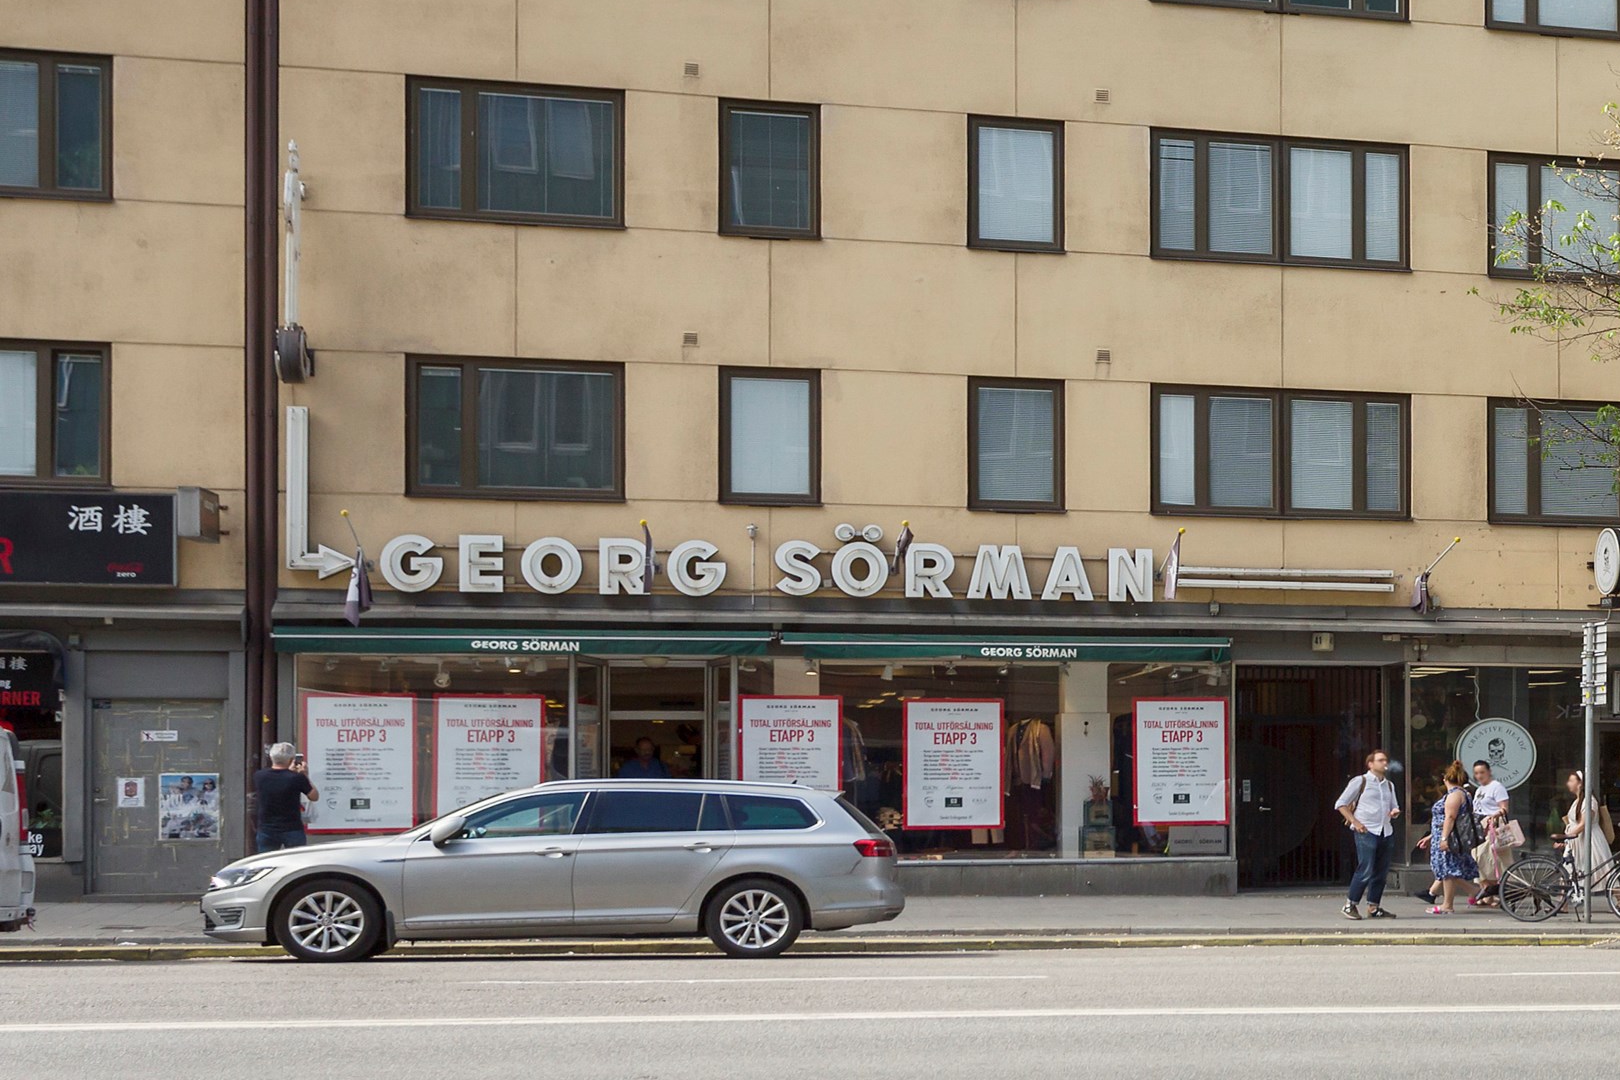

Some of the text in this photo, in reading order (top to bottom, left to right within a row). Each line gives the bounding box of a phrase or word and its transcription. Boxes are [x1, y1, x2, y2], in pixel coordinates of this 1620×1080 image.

[67, 504, 152, 535] 酒樓
[380, 523, 1154, 602] GEORG SÖRMAN
[471, 638, 580, 652] GEORG SÖRMAN
[981, 645, 1077, 658] GEORG SÖRMAN
[2, 691, 41, 705] RNER
[316, 717, 405, 727] TOTAL UTFÖRSÄLJNING
[446, 717, 534, 727] TOTAL UTFÖRSÄLJNING
[750, 718, 832, 728] TOTAL UTFÖRSÄLJNING
[915, 721, 994, 730] TOTAL UTFÖRSÄLJNING
[1143, 719, 1218, 728] TOTAL UTFÖRSÄLJNING
[337, 729, 387, 743] ETAPP 3
[467, 730, 515, 743] ETAPP 3
[769, 730, 815, 742] ETAPP 3
[934, 732, 977, 745] ETAPP 3
[1162, 730, 1203, 743] ETAPP 3
[1467, 726, 1527, 751] CREATIVE HEADZ
